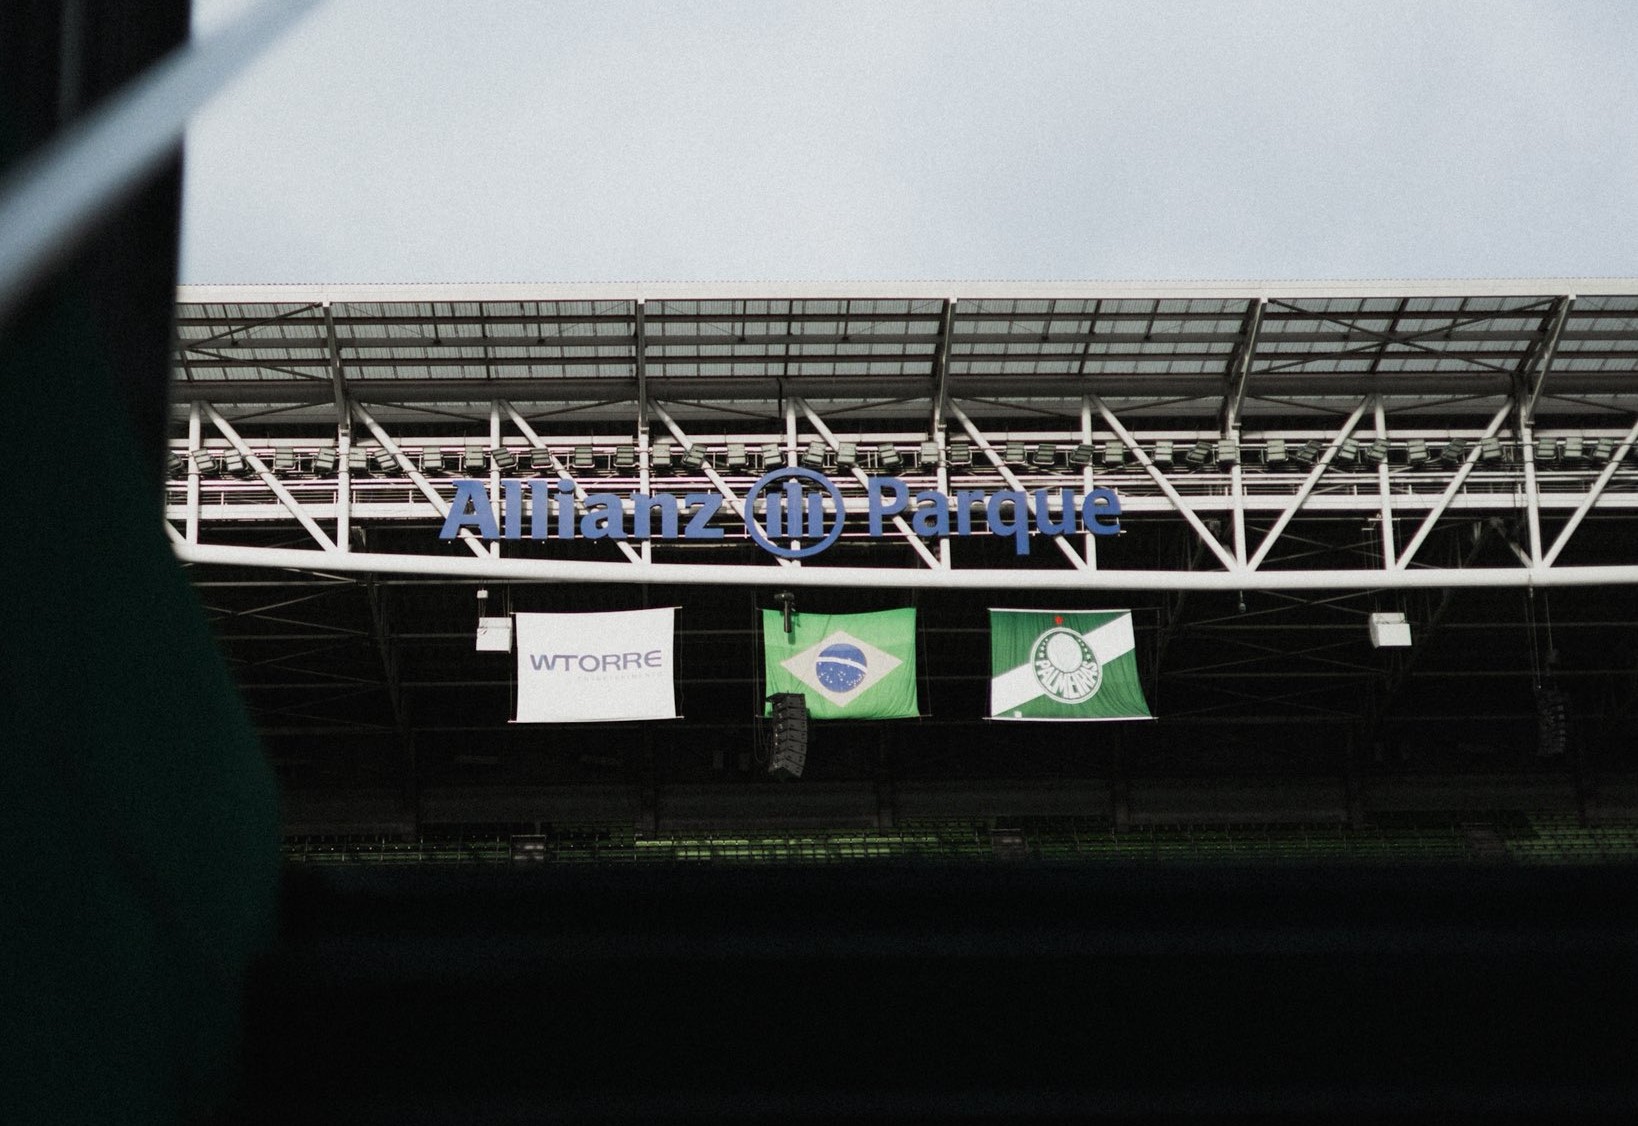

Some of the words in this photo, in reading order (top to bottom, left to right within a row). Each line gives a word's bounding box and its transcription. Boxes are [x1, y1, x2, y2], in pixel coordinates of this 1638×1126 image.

[439, 479, 725, 539] Allianz
[869, 476, 1123, 555] Parque
[530, 650, 662, 672] WTORRE
[1035, 659, 1098, 699] PALMEIRAS
